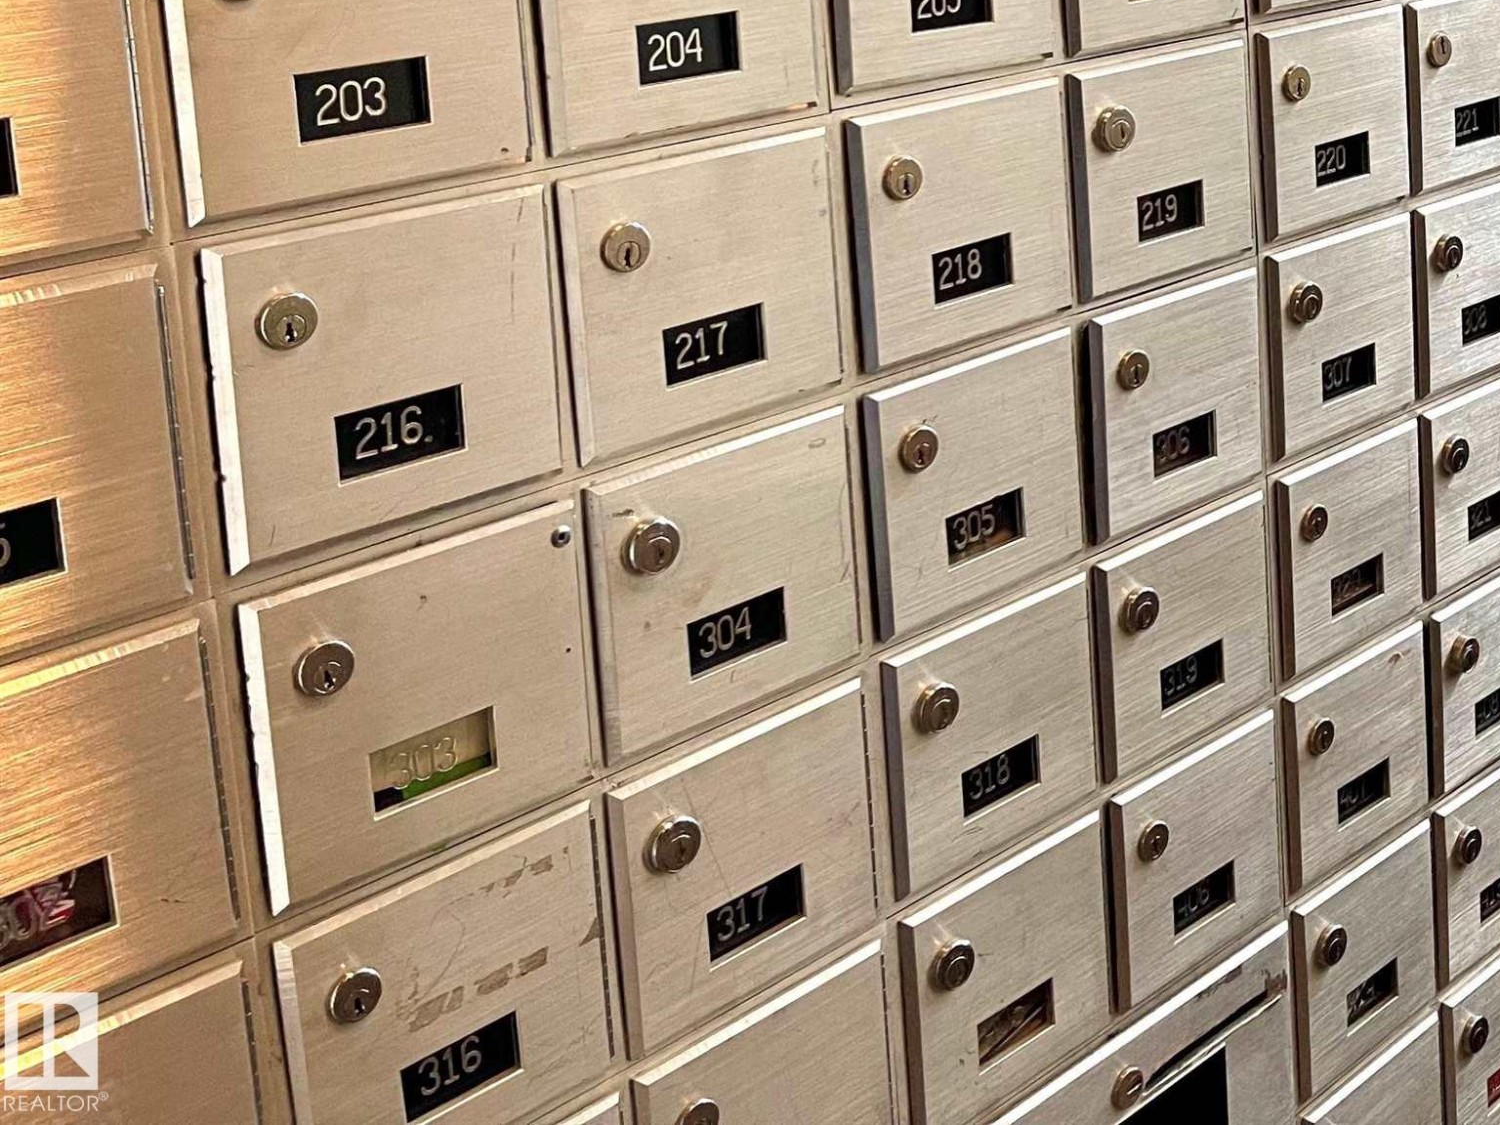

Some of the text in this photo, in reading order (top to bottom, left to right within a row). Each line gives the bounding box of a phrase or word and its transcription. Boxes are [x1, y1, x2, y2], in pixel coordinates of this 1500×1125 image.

[647, 28, 704, 72] 204
[315, 76, 387, 127] 203
[1456, 108, 1479, 137] 221
[1317, 144, 1346, 177] 220
[1142, 194, 1178, 231] 219
[938, 248, 983, 290] 218
[675, 322, 728, 370] 217
[1324, 357, 1352, 391] 307
[1157, 426, 1191, 464] 306
[952, 504, 996, 550] 305
[698, 606, 753, 660] 304
[1164, 654, 1197, 696] 319
[392, 736, 460, 789] 303
[969, 753, 1010, 799] 318
[716, 887, 769, 942] 317
[419, 1034, 483, 1096] 316
